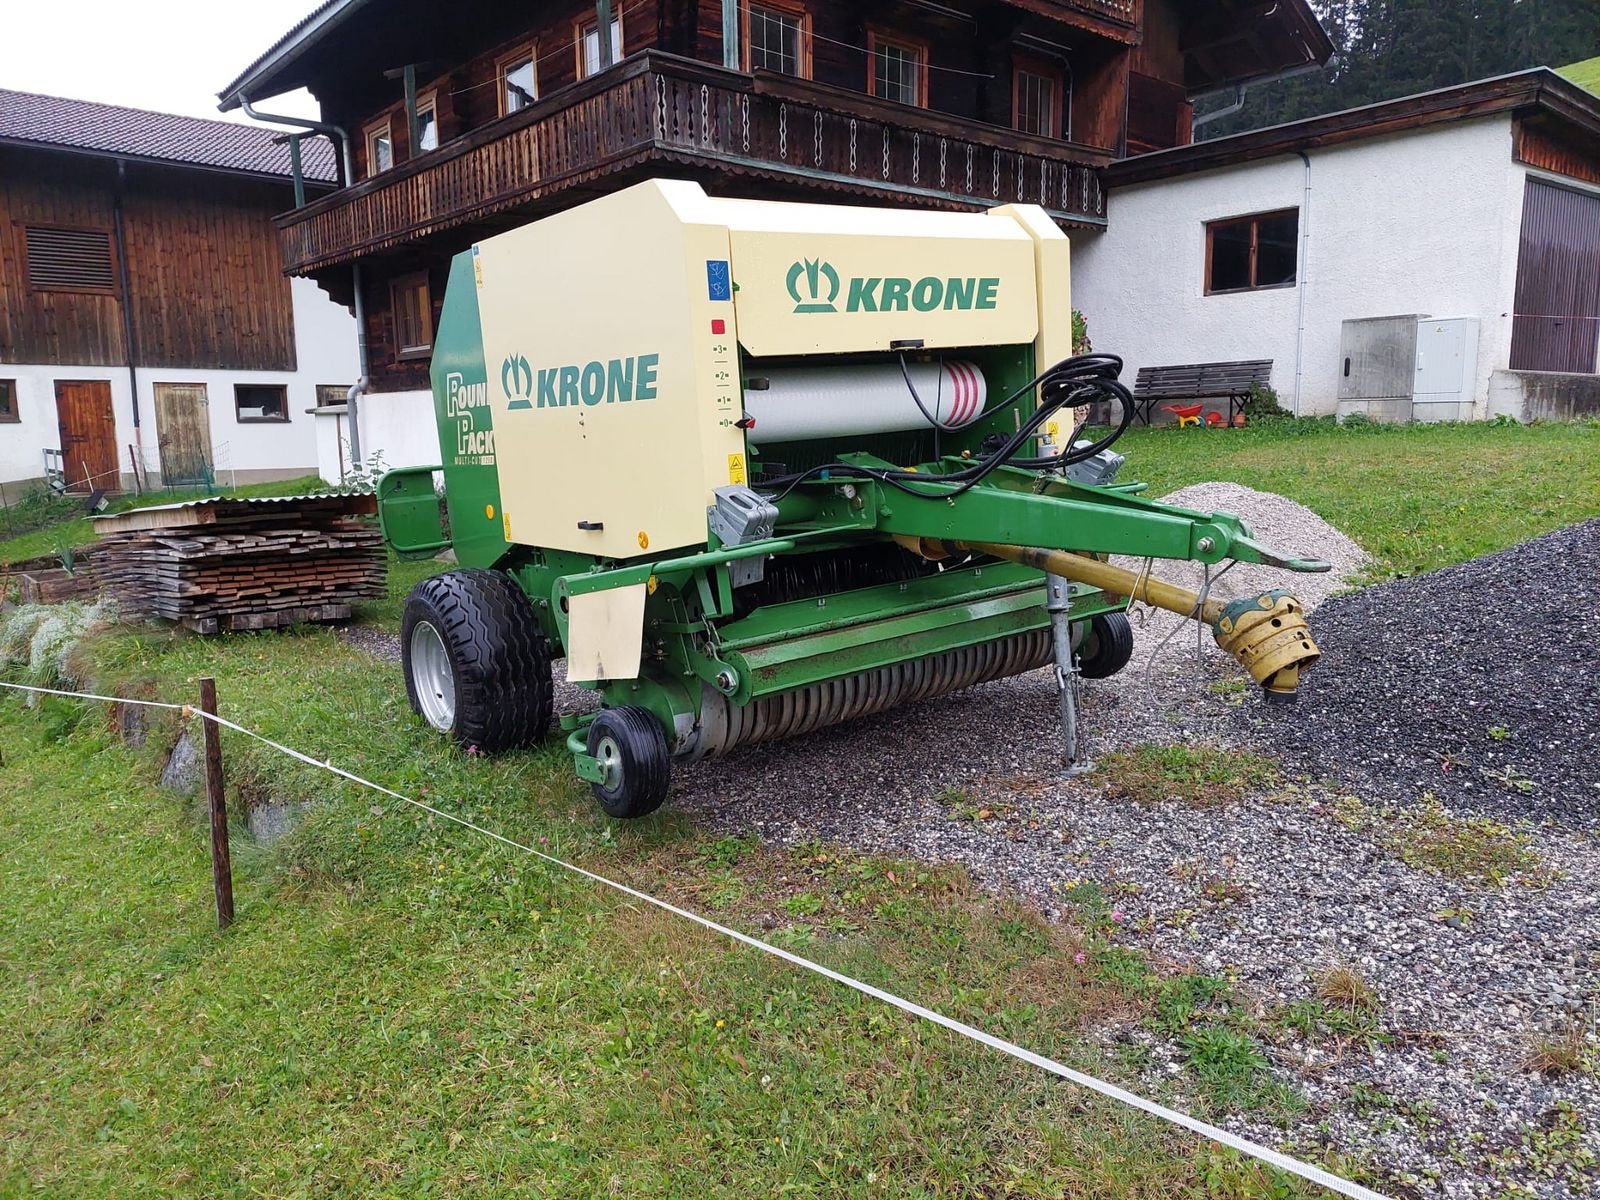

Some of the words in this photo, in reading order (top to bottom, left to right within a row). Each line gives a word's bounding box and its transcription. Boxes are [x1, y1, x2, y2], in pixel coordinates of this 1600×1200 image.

[845, 275, 1000, 313] KRONE
[536, 352, 660, 409] KRONE
[457, 411, 495, 455] PACK
